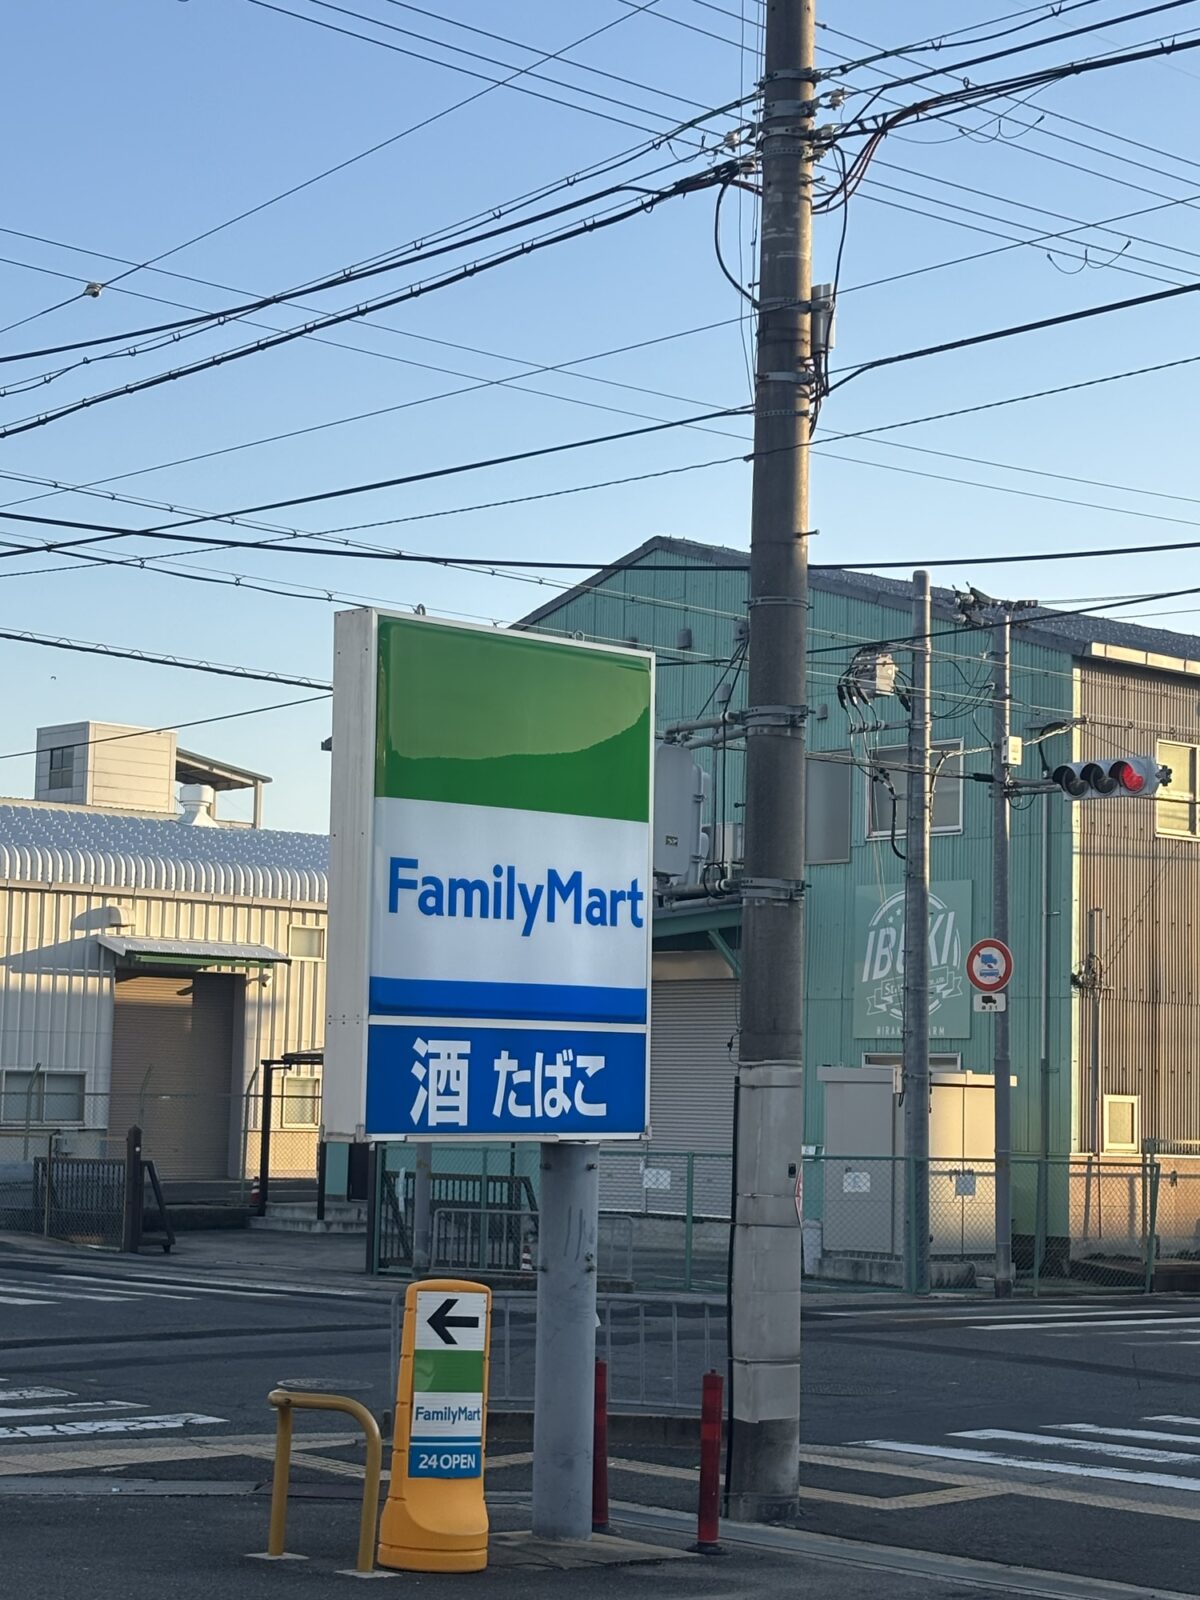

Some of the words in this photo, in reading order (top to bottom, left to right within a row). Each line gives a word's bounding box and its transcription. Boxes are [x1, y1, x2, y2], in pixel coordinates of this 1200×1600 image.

[388, 856, 644, 937] FamilyMart
[409, 1037, 472, 1127] 酒
[492, 1048, 608, 1120] たばこ
[415, 1406, 481, 1425] FamilyMart
[439, 1453, 476, 1470] OPEN
